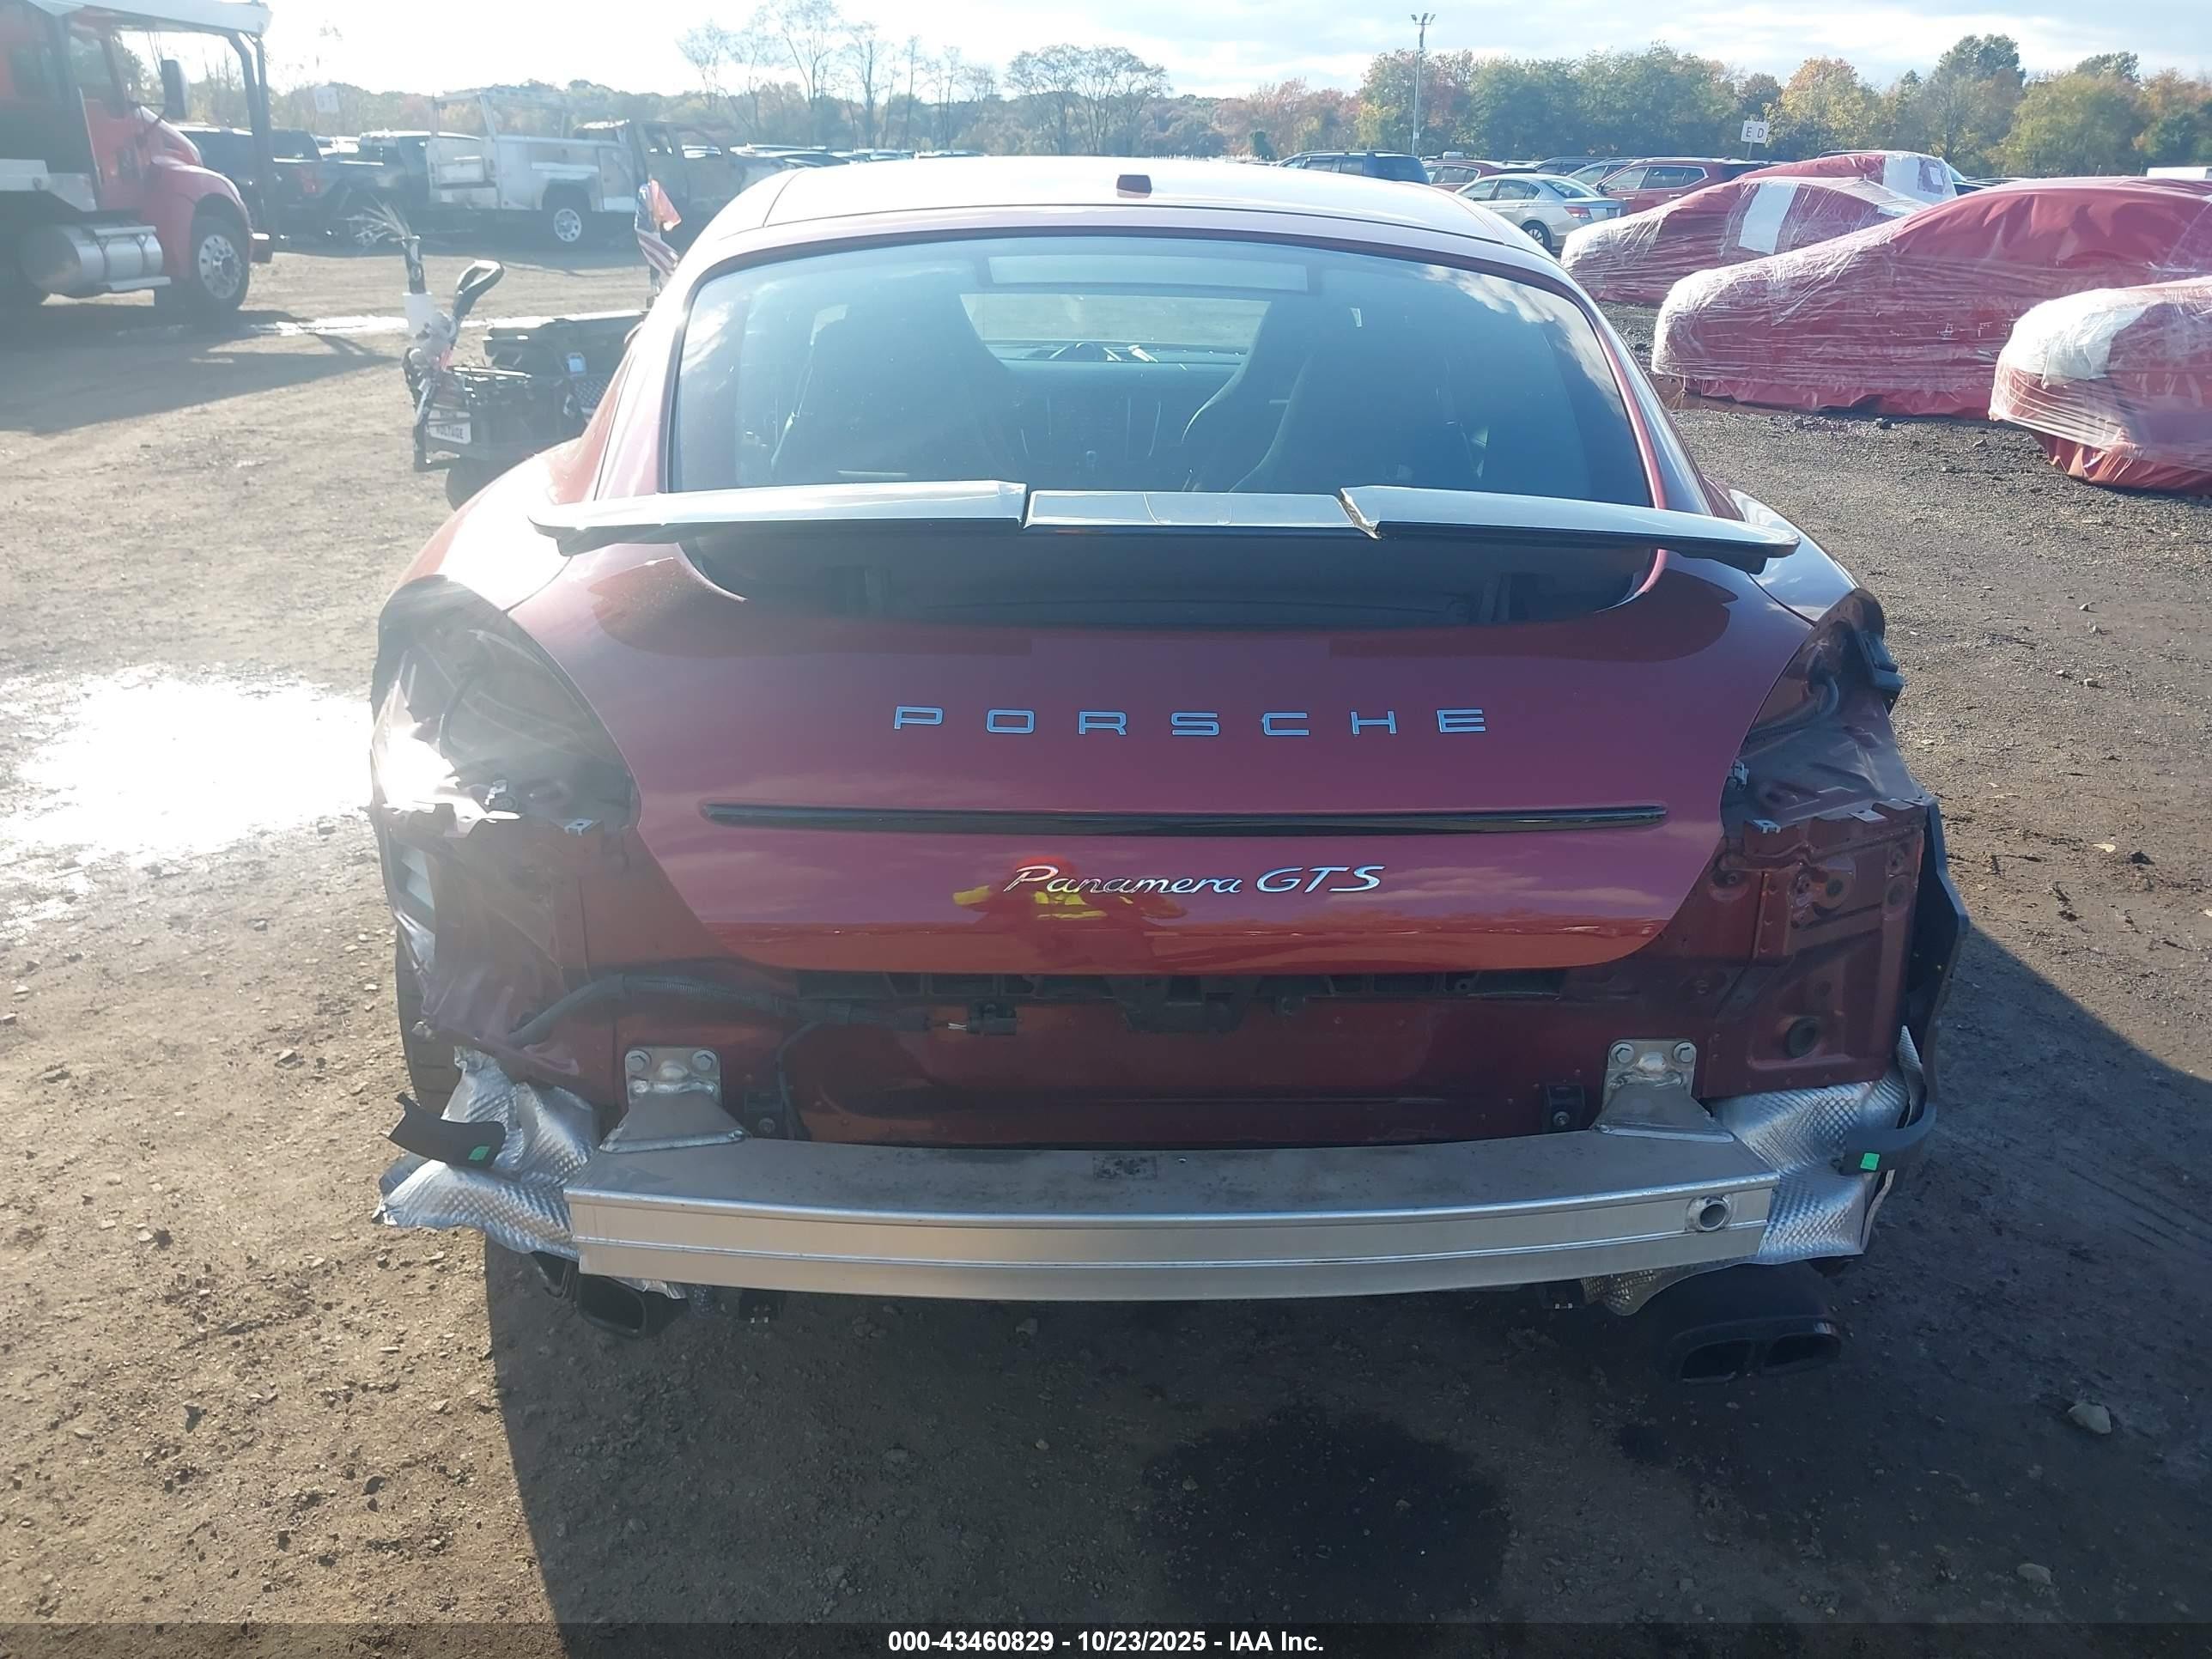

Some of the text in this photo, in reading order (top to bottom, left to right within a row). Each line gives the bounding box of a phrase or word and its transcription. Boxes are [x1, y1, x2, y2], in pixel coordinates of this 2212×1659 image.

[1746, 126, 1765, 138] E D
[894, 706, 1486, 736] PORSCHE
[1003, 864, 1386, 894] Panamera GTS
